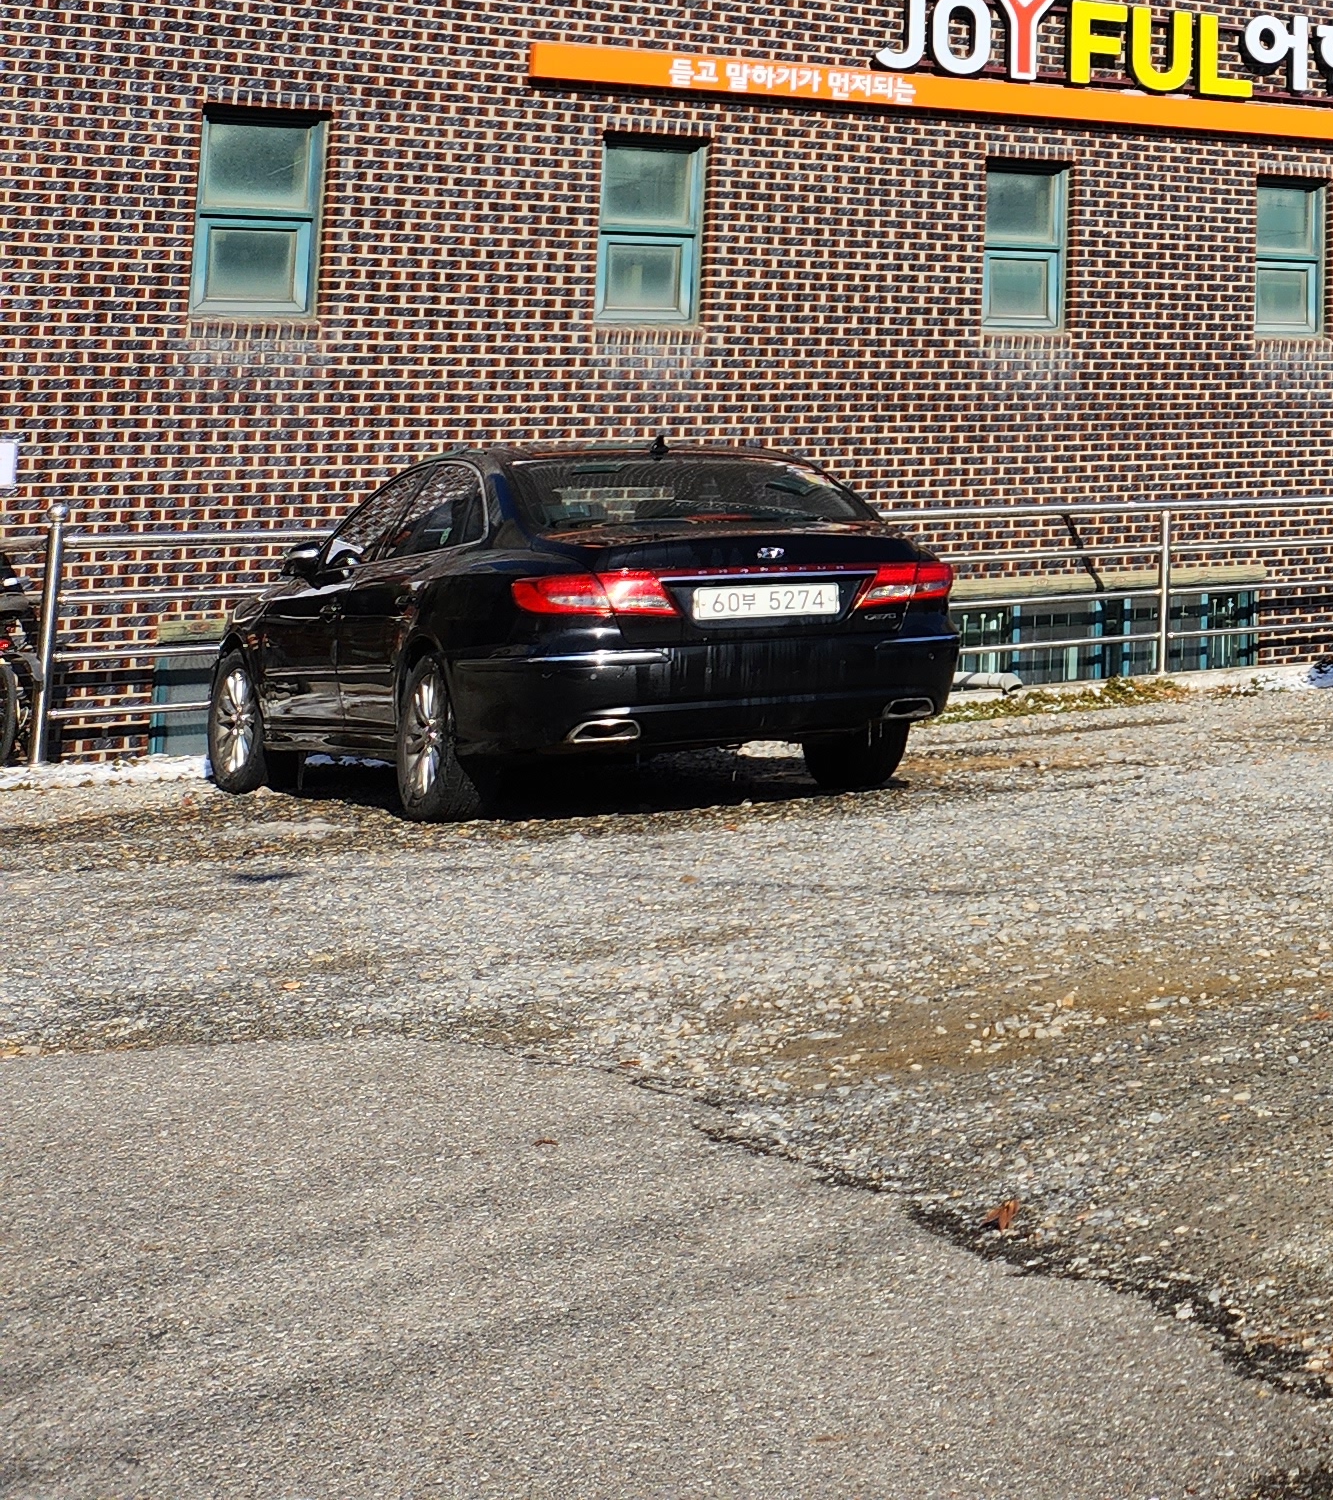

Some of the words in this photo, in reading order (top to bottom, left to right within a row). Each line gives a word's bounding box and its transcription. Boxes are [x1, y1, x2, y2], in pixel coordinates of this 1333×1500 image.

[668, 58, 719, 86] 듣고
[725, 61, 822, 92] 말하기가
[827, 71, 917, 103] 먼저되는
[711, 591, 757, 614] 60부
[768, 589, 826, 611] 5274
